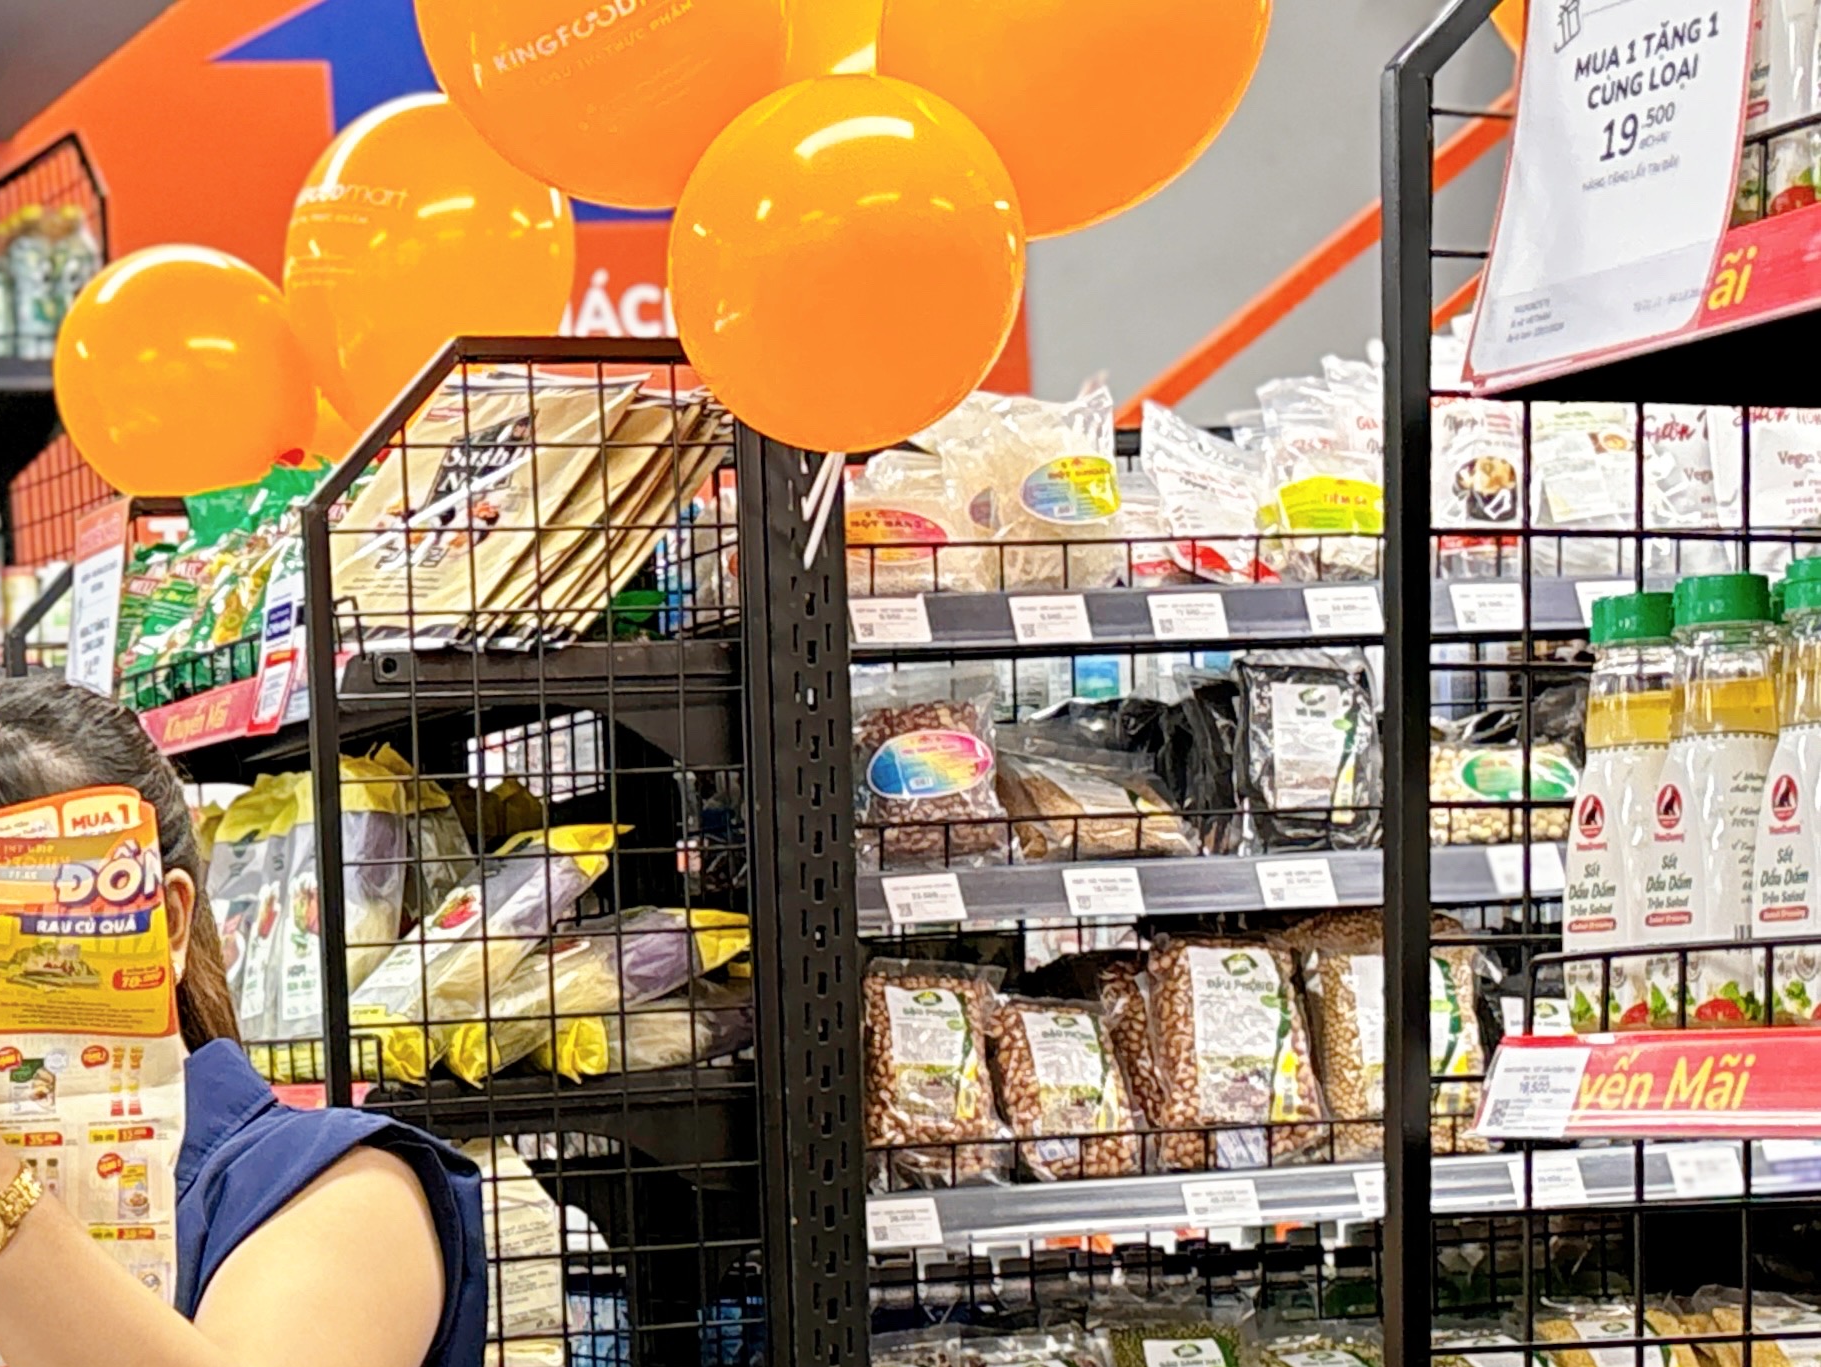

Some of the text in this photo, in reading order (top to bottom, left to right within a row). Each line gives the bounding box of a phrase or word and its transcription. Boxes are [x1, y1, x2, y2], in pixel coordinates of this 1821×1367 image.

[492, 0, 648, 73] KINGFOOD
[1574, 11, 1720, 81] MUA 1 TẶNG 1
[1587, 54, 1700, 110] CÙNG LOẠI
[71, 803, 130, 830] MUA 1
[36, 919, 73, 933] RAU
[1662, 1052, 1757, 1111] Mãi
